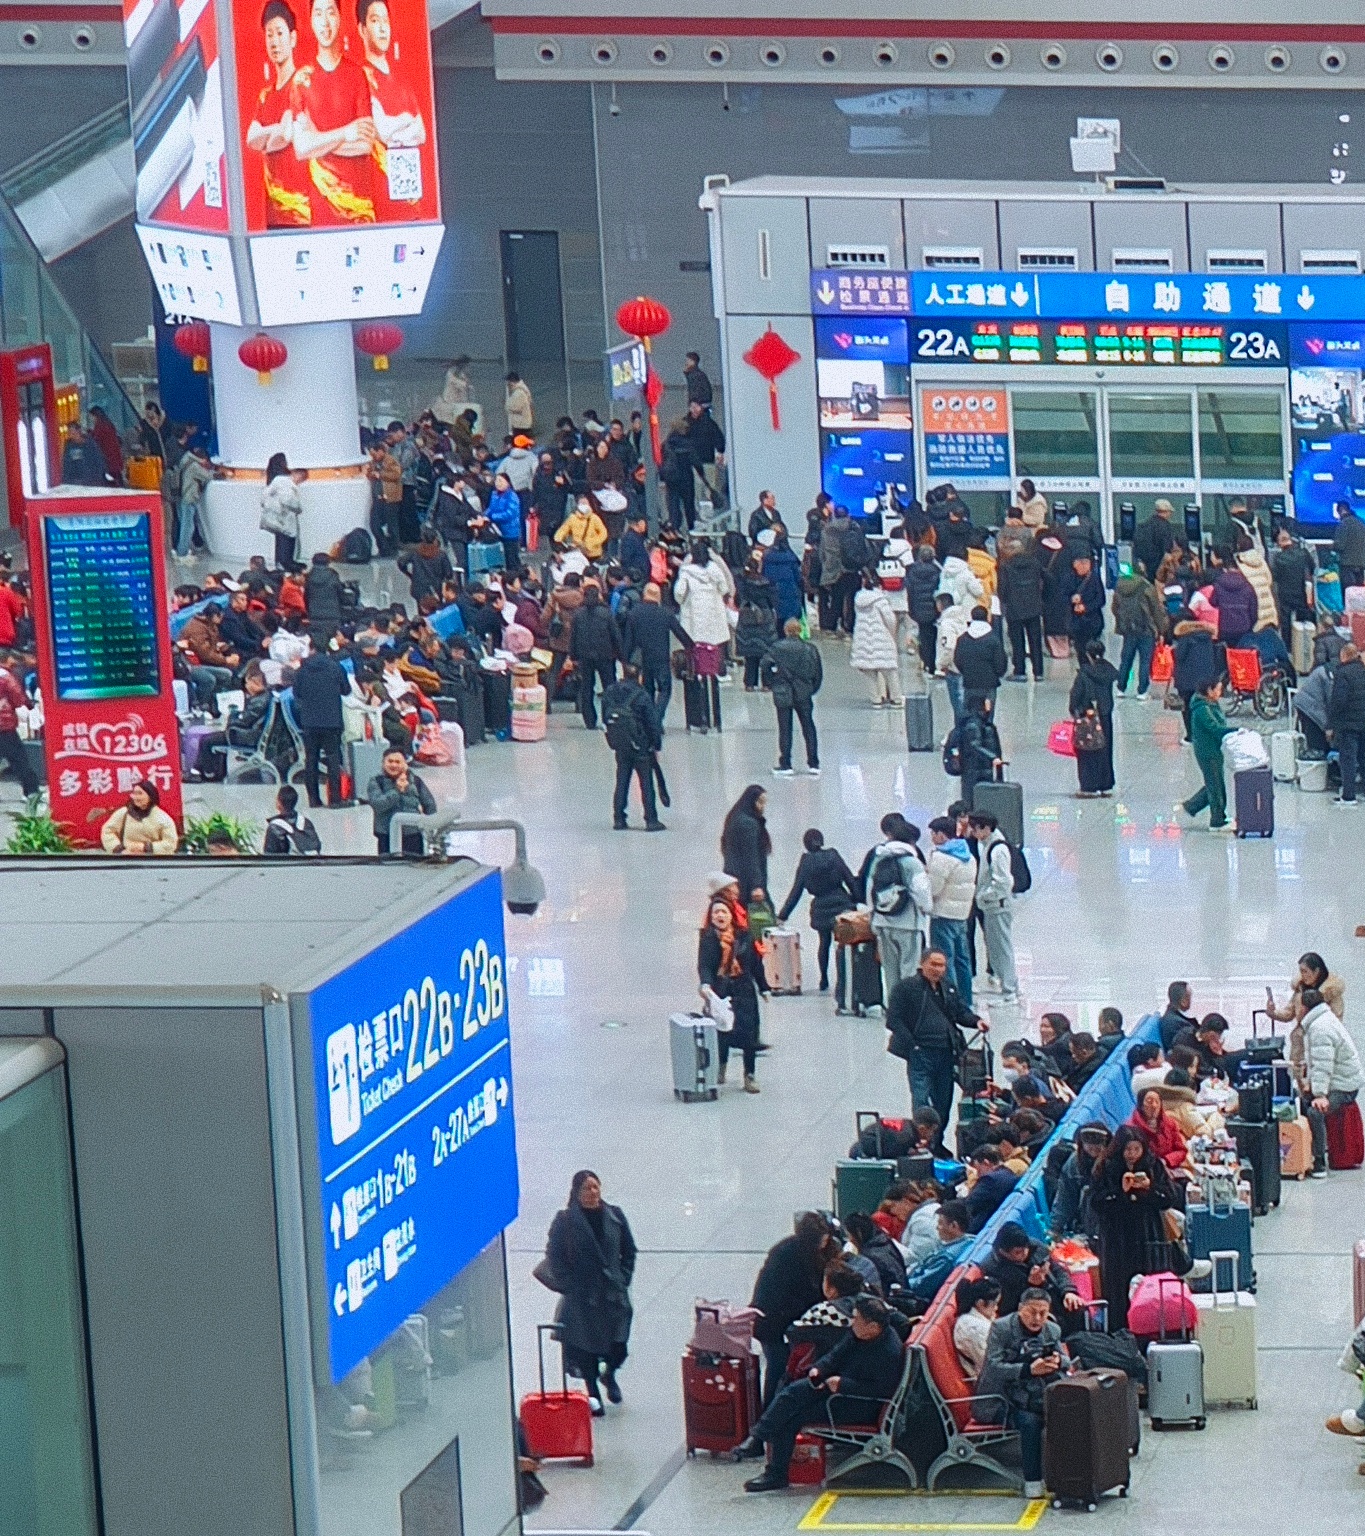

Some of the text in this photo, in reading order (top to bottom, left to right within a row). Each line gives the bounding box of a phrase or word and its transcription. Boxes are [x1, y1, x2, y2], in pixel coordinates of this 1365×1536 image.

[925, 282, 1007, 306] 人工通道
[1105, 279, 1282, 313] 自助通道
[917, 329, 971, 357] 22A
[1229, 331, 1282, 360] 23A
[103, 733, 167, 753] 12306
[358, 1003, 404, 1083] 检票口
